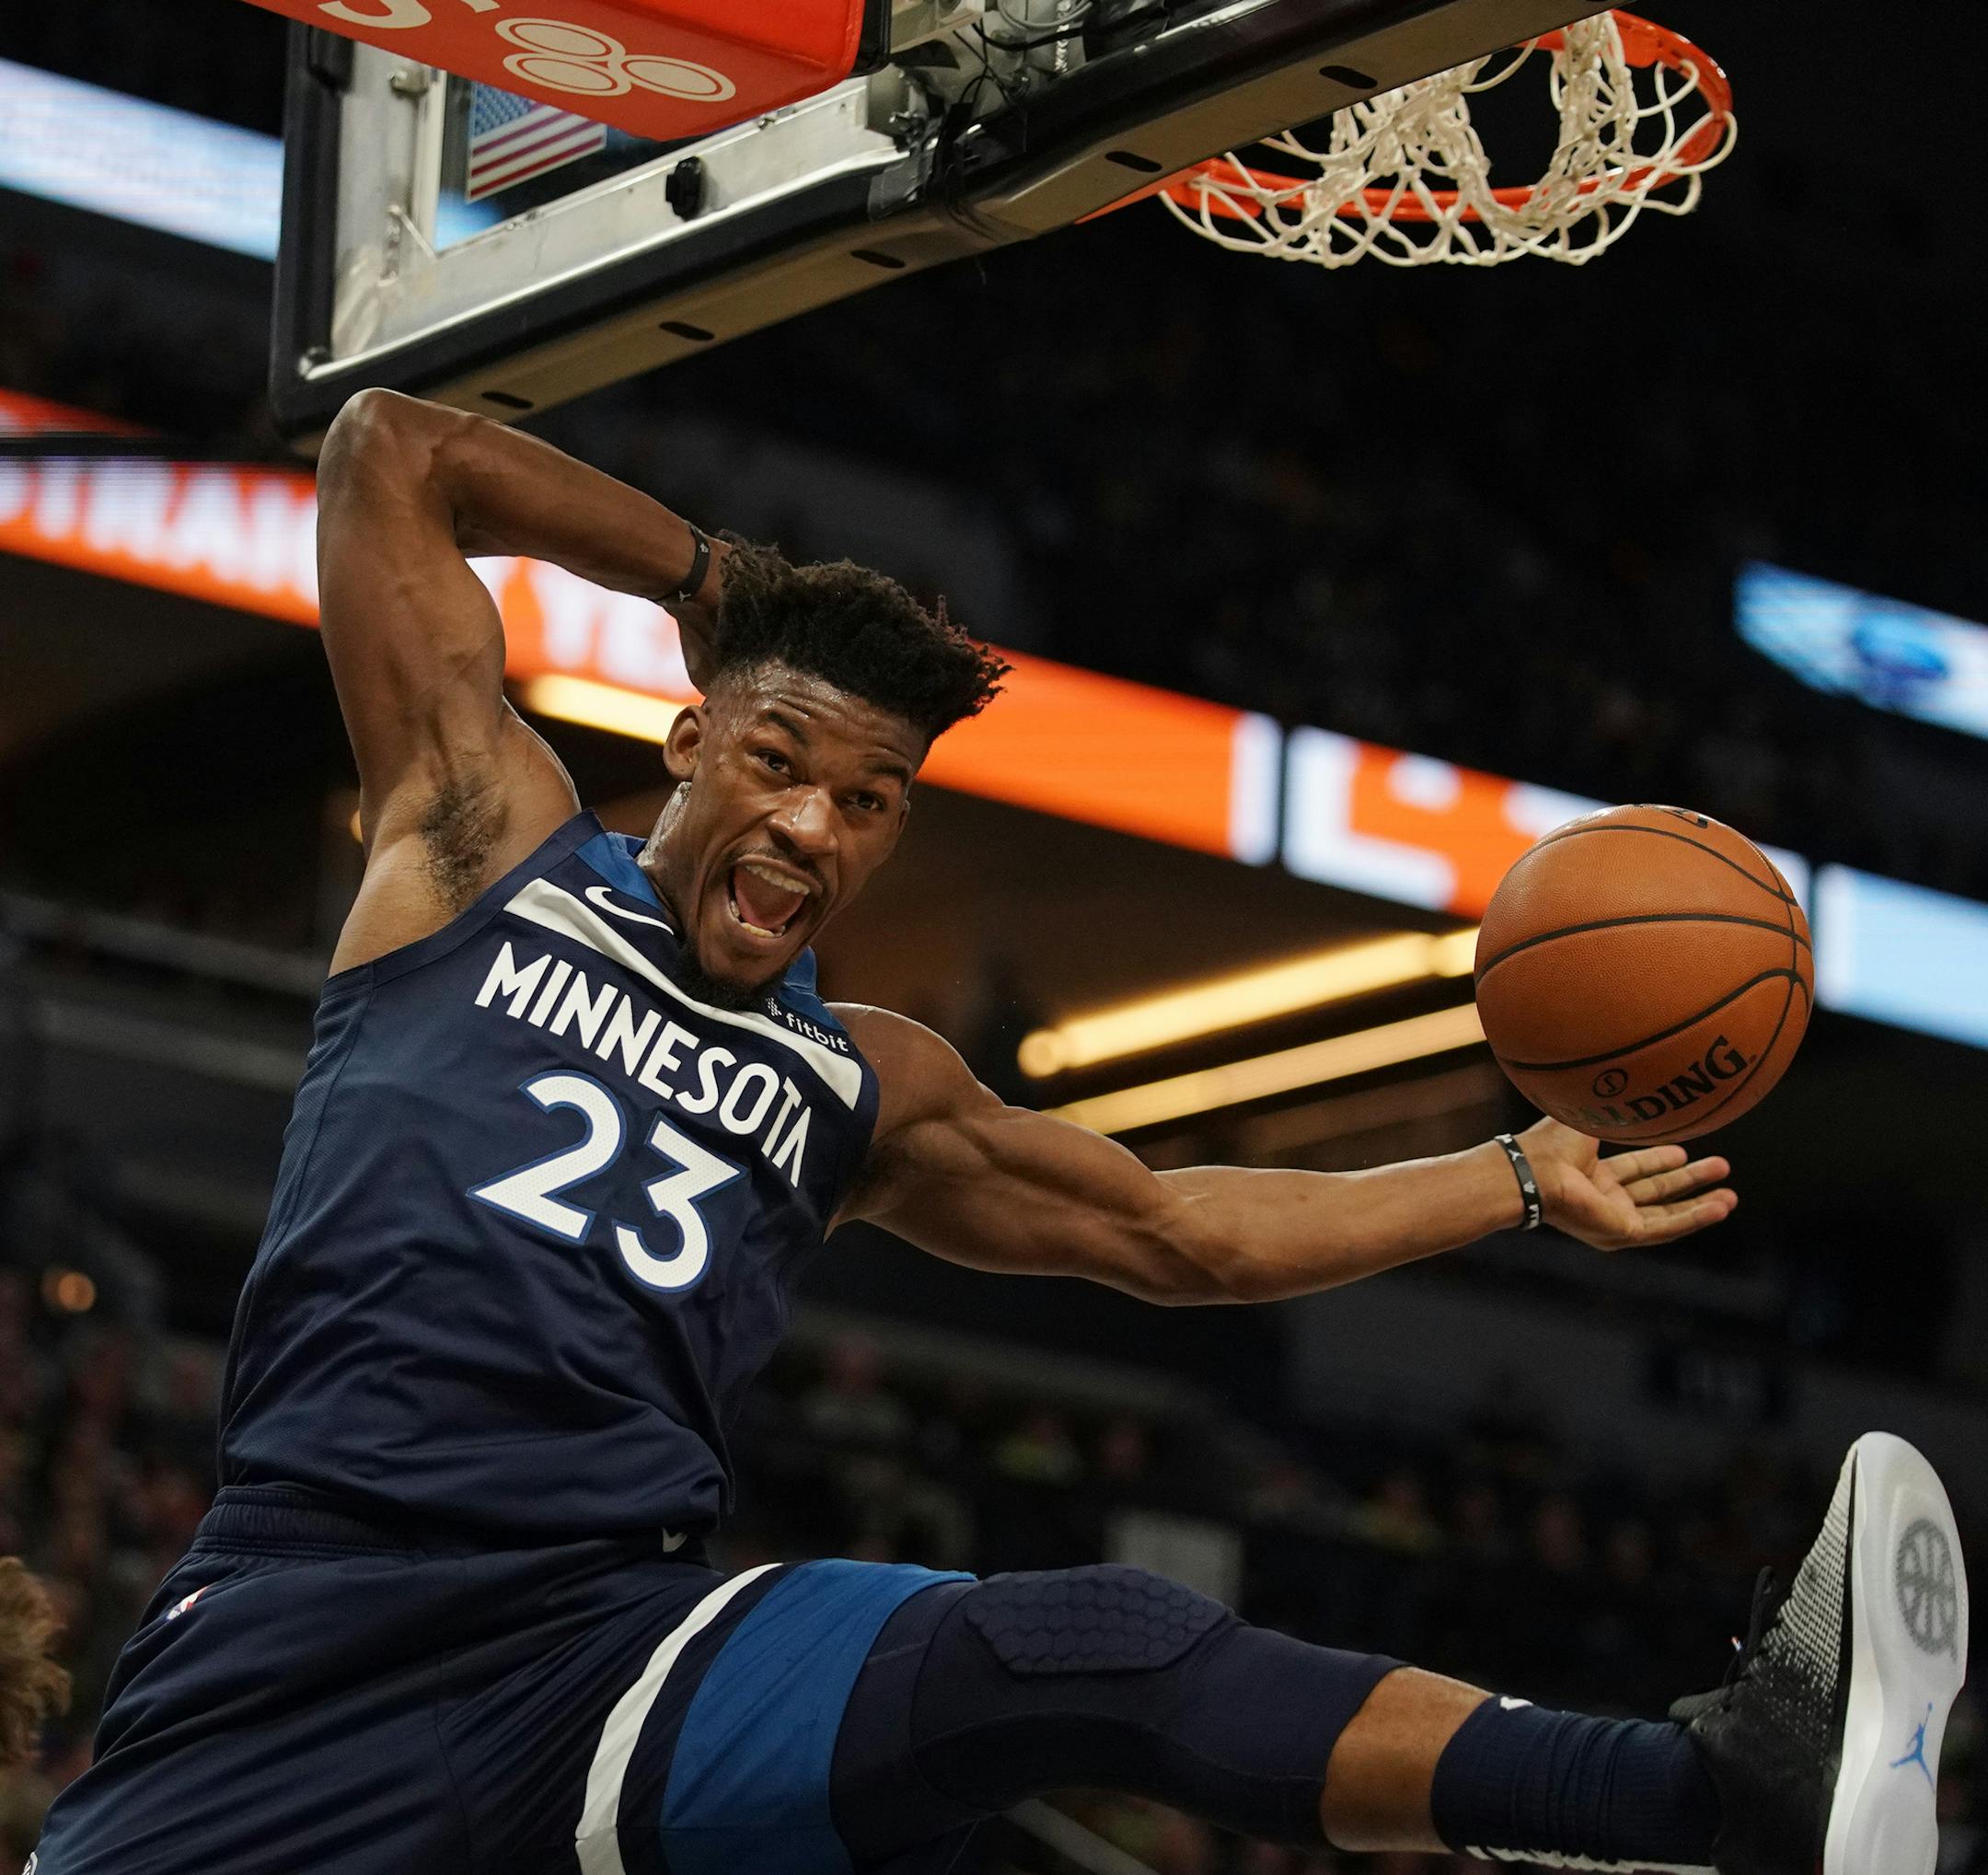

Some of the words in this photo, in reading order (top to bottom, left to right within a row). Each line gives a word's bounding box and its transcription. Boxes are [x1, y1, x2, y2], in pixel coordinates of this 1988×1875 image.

[474, 941, 811, 1188] MINNESOTA
[786, 1013, 849, 1052] fitbit
[467, 1070, 747, 1293] 23
